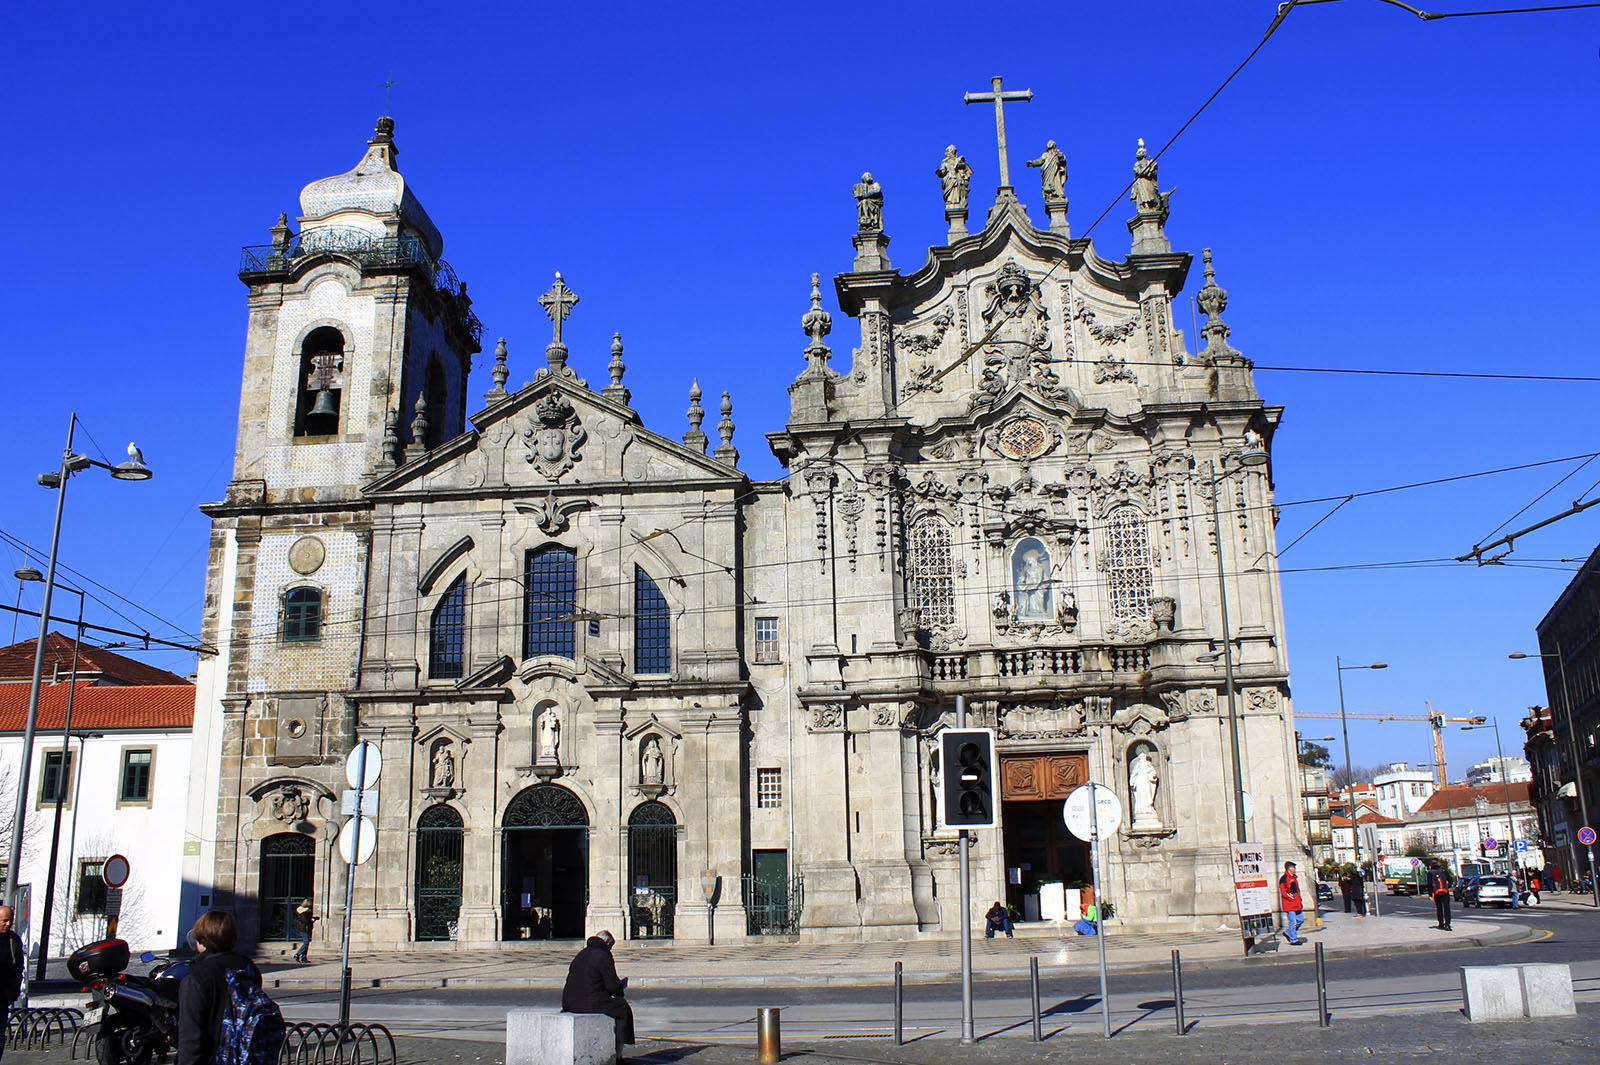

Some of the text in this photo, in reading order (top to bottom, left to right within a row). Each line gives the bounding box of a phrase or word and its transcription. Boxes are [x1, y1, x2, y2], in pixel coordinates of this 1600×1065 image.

[1516, 841, 1525, 852] P
[1240, 852, 1262, 862] DIREITOS
[1238, 864, 1259, 873] FUTURO
